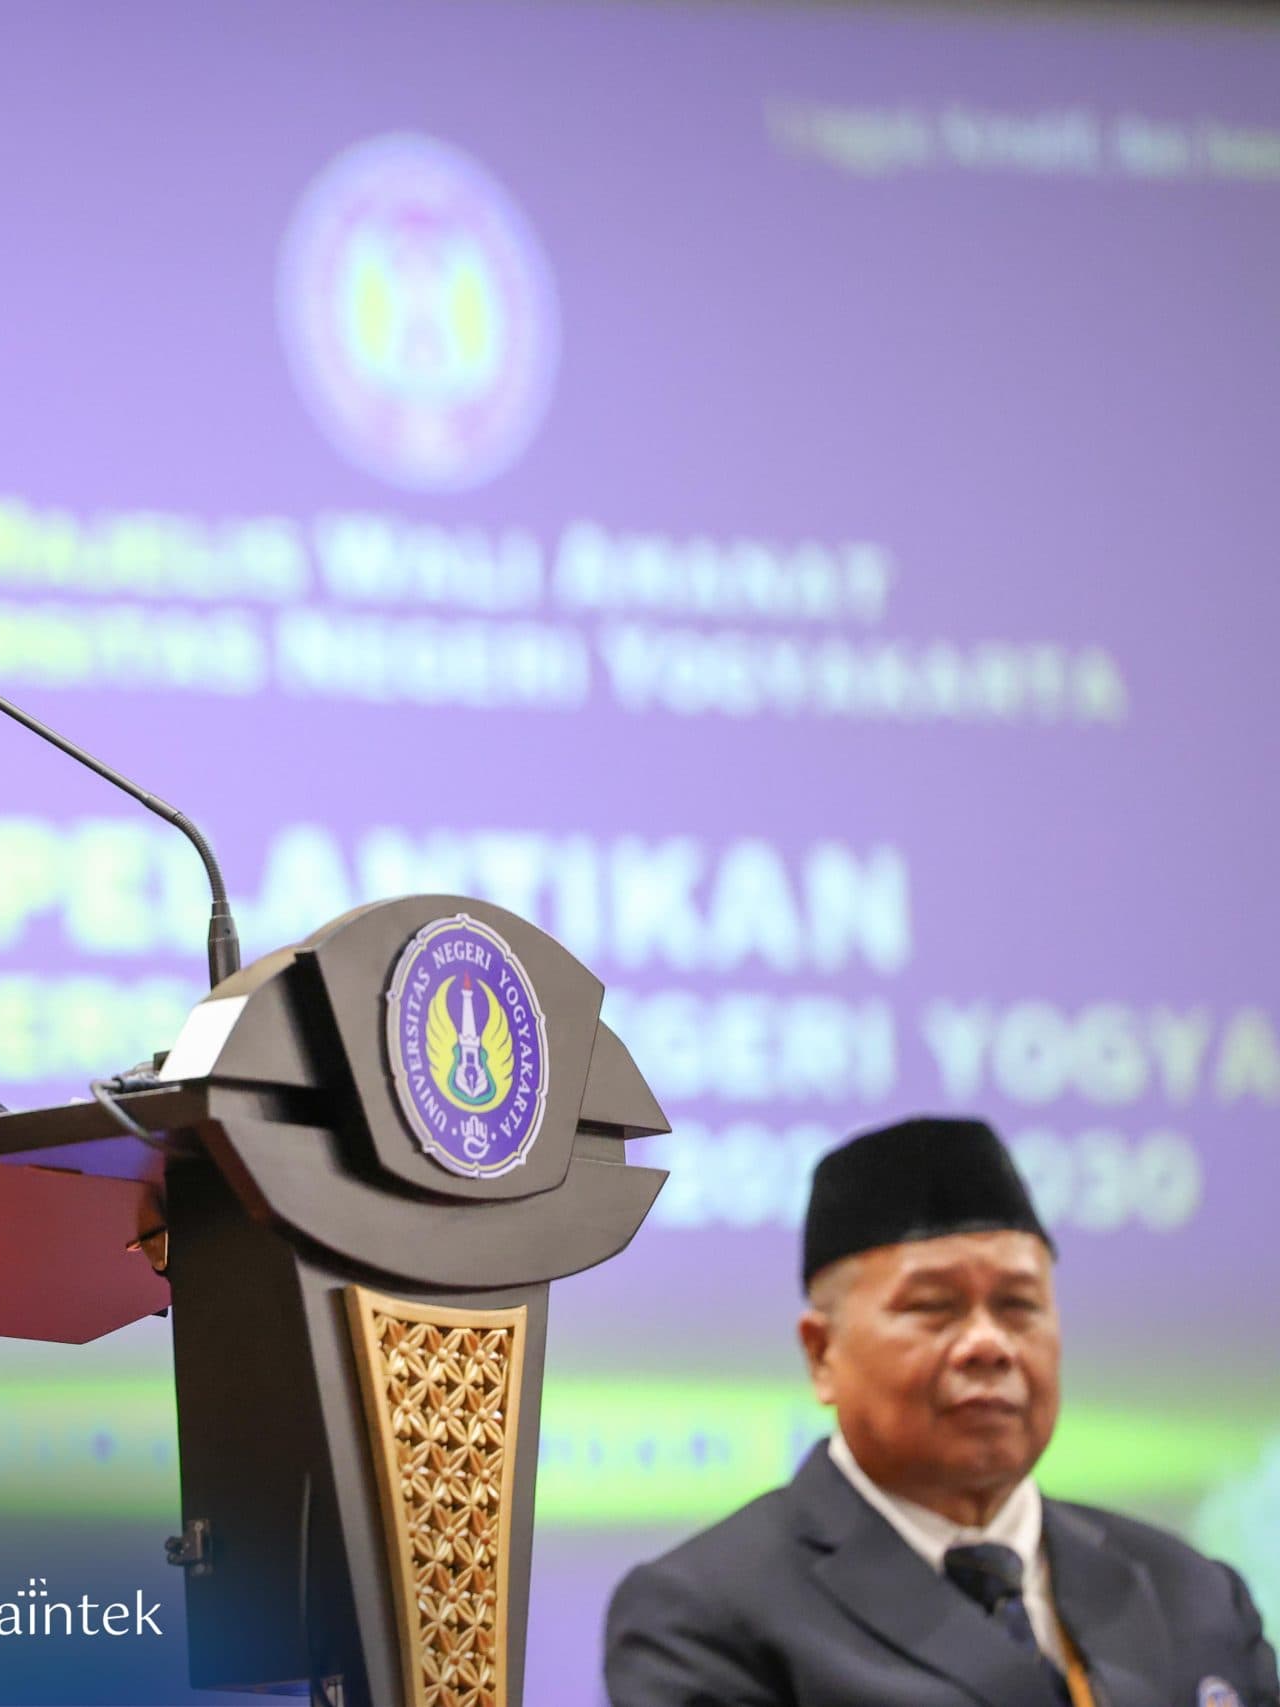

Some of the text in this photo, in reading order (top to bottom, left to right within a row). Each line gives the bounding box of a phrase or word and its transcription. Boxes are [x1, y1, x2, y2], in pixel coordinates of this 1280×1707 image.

[405, 940, 535, 1138] UNIVERSITAS NEGERI YOGYAKARTA
